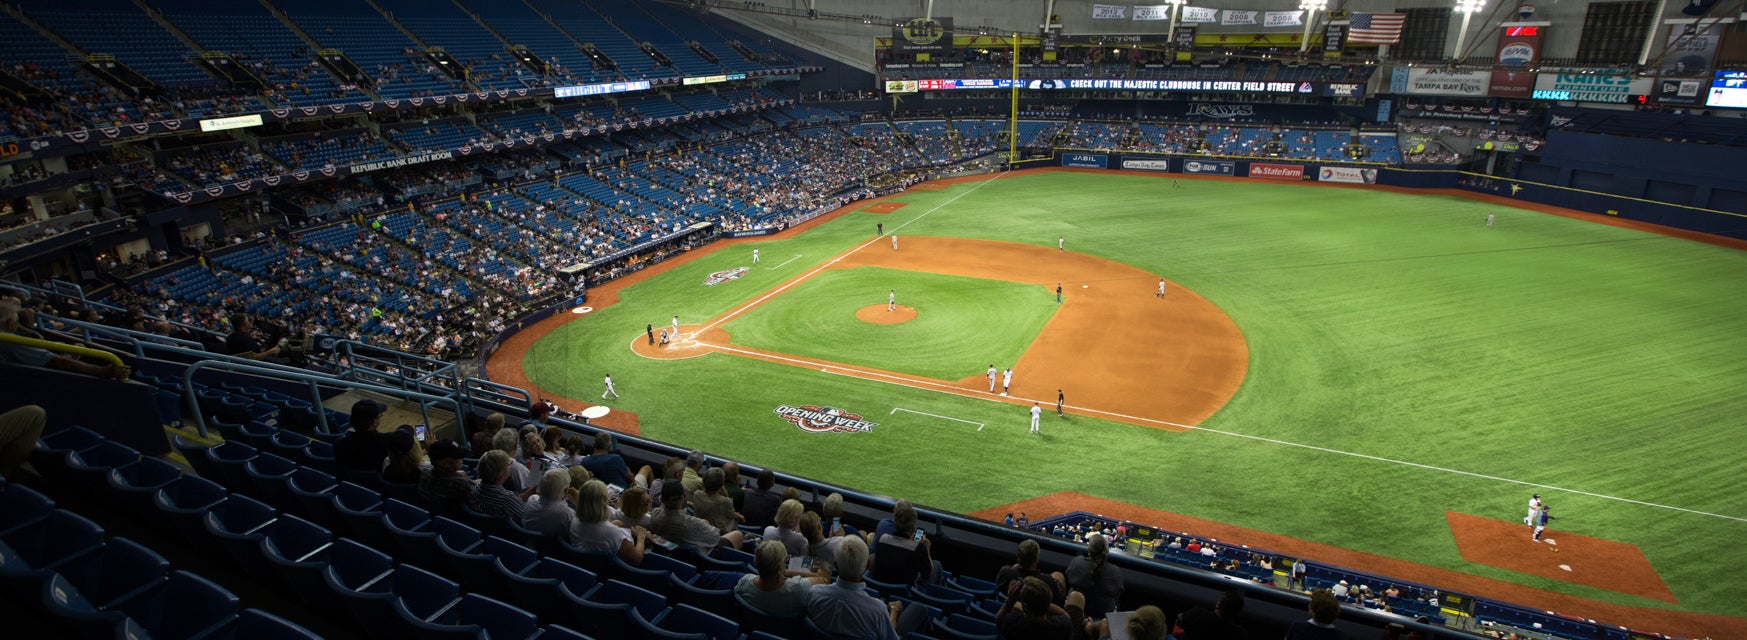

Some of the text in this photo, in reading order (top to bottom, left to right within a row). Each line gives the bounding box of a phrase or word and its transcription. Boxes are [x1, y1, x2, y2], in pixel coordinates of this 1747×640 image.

[1124, 80, 1157, 89] MAJESTIC
[1160, 81, 1201, 90] CLUBHOUSE
[1203, 81, 1211, 90] IN
[1214, 82, 1241, 90] CENTER
[1243, 82, 1264, 91] FIELD
[1267, 82, 1295, 92] STREET
[1555, 84, 1629, 92] FURNITURE
[1638, 95, 1646, 104] 4
[1186, 103, 1253, 117] RAYS
[350, 152, 452, 173] REPUBLIC BANK DRAFT ROOM
[776, 406, 873, 431] OPENING WEEK
